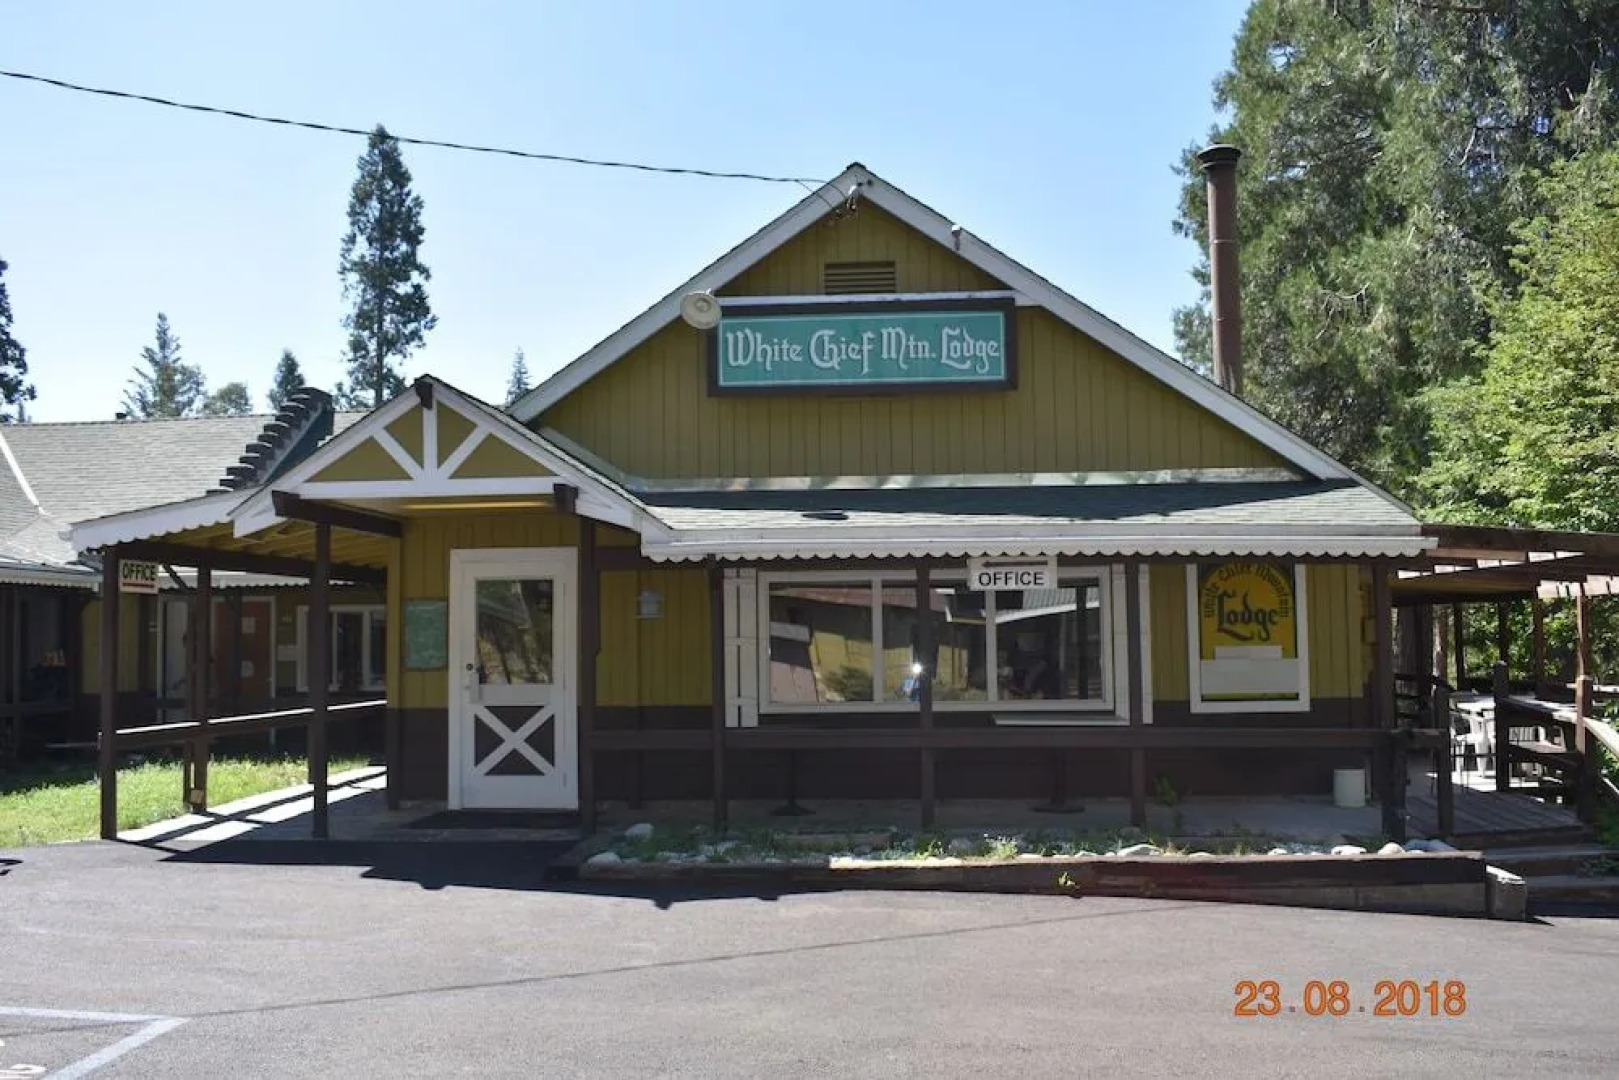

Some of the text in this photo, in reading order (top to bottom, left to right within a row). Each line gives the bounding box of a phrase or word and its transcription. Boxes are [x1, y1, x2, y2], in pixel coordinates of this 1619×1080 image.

[726, 326, 999, 375] White Chief Mtn. Lodge
[122, 563, 156, 581] OFFICE
[978, 570, 1044, 587] OFFICE
[1217, 588, 1281, 642] Lodge
